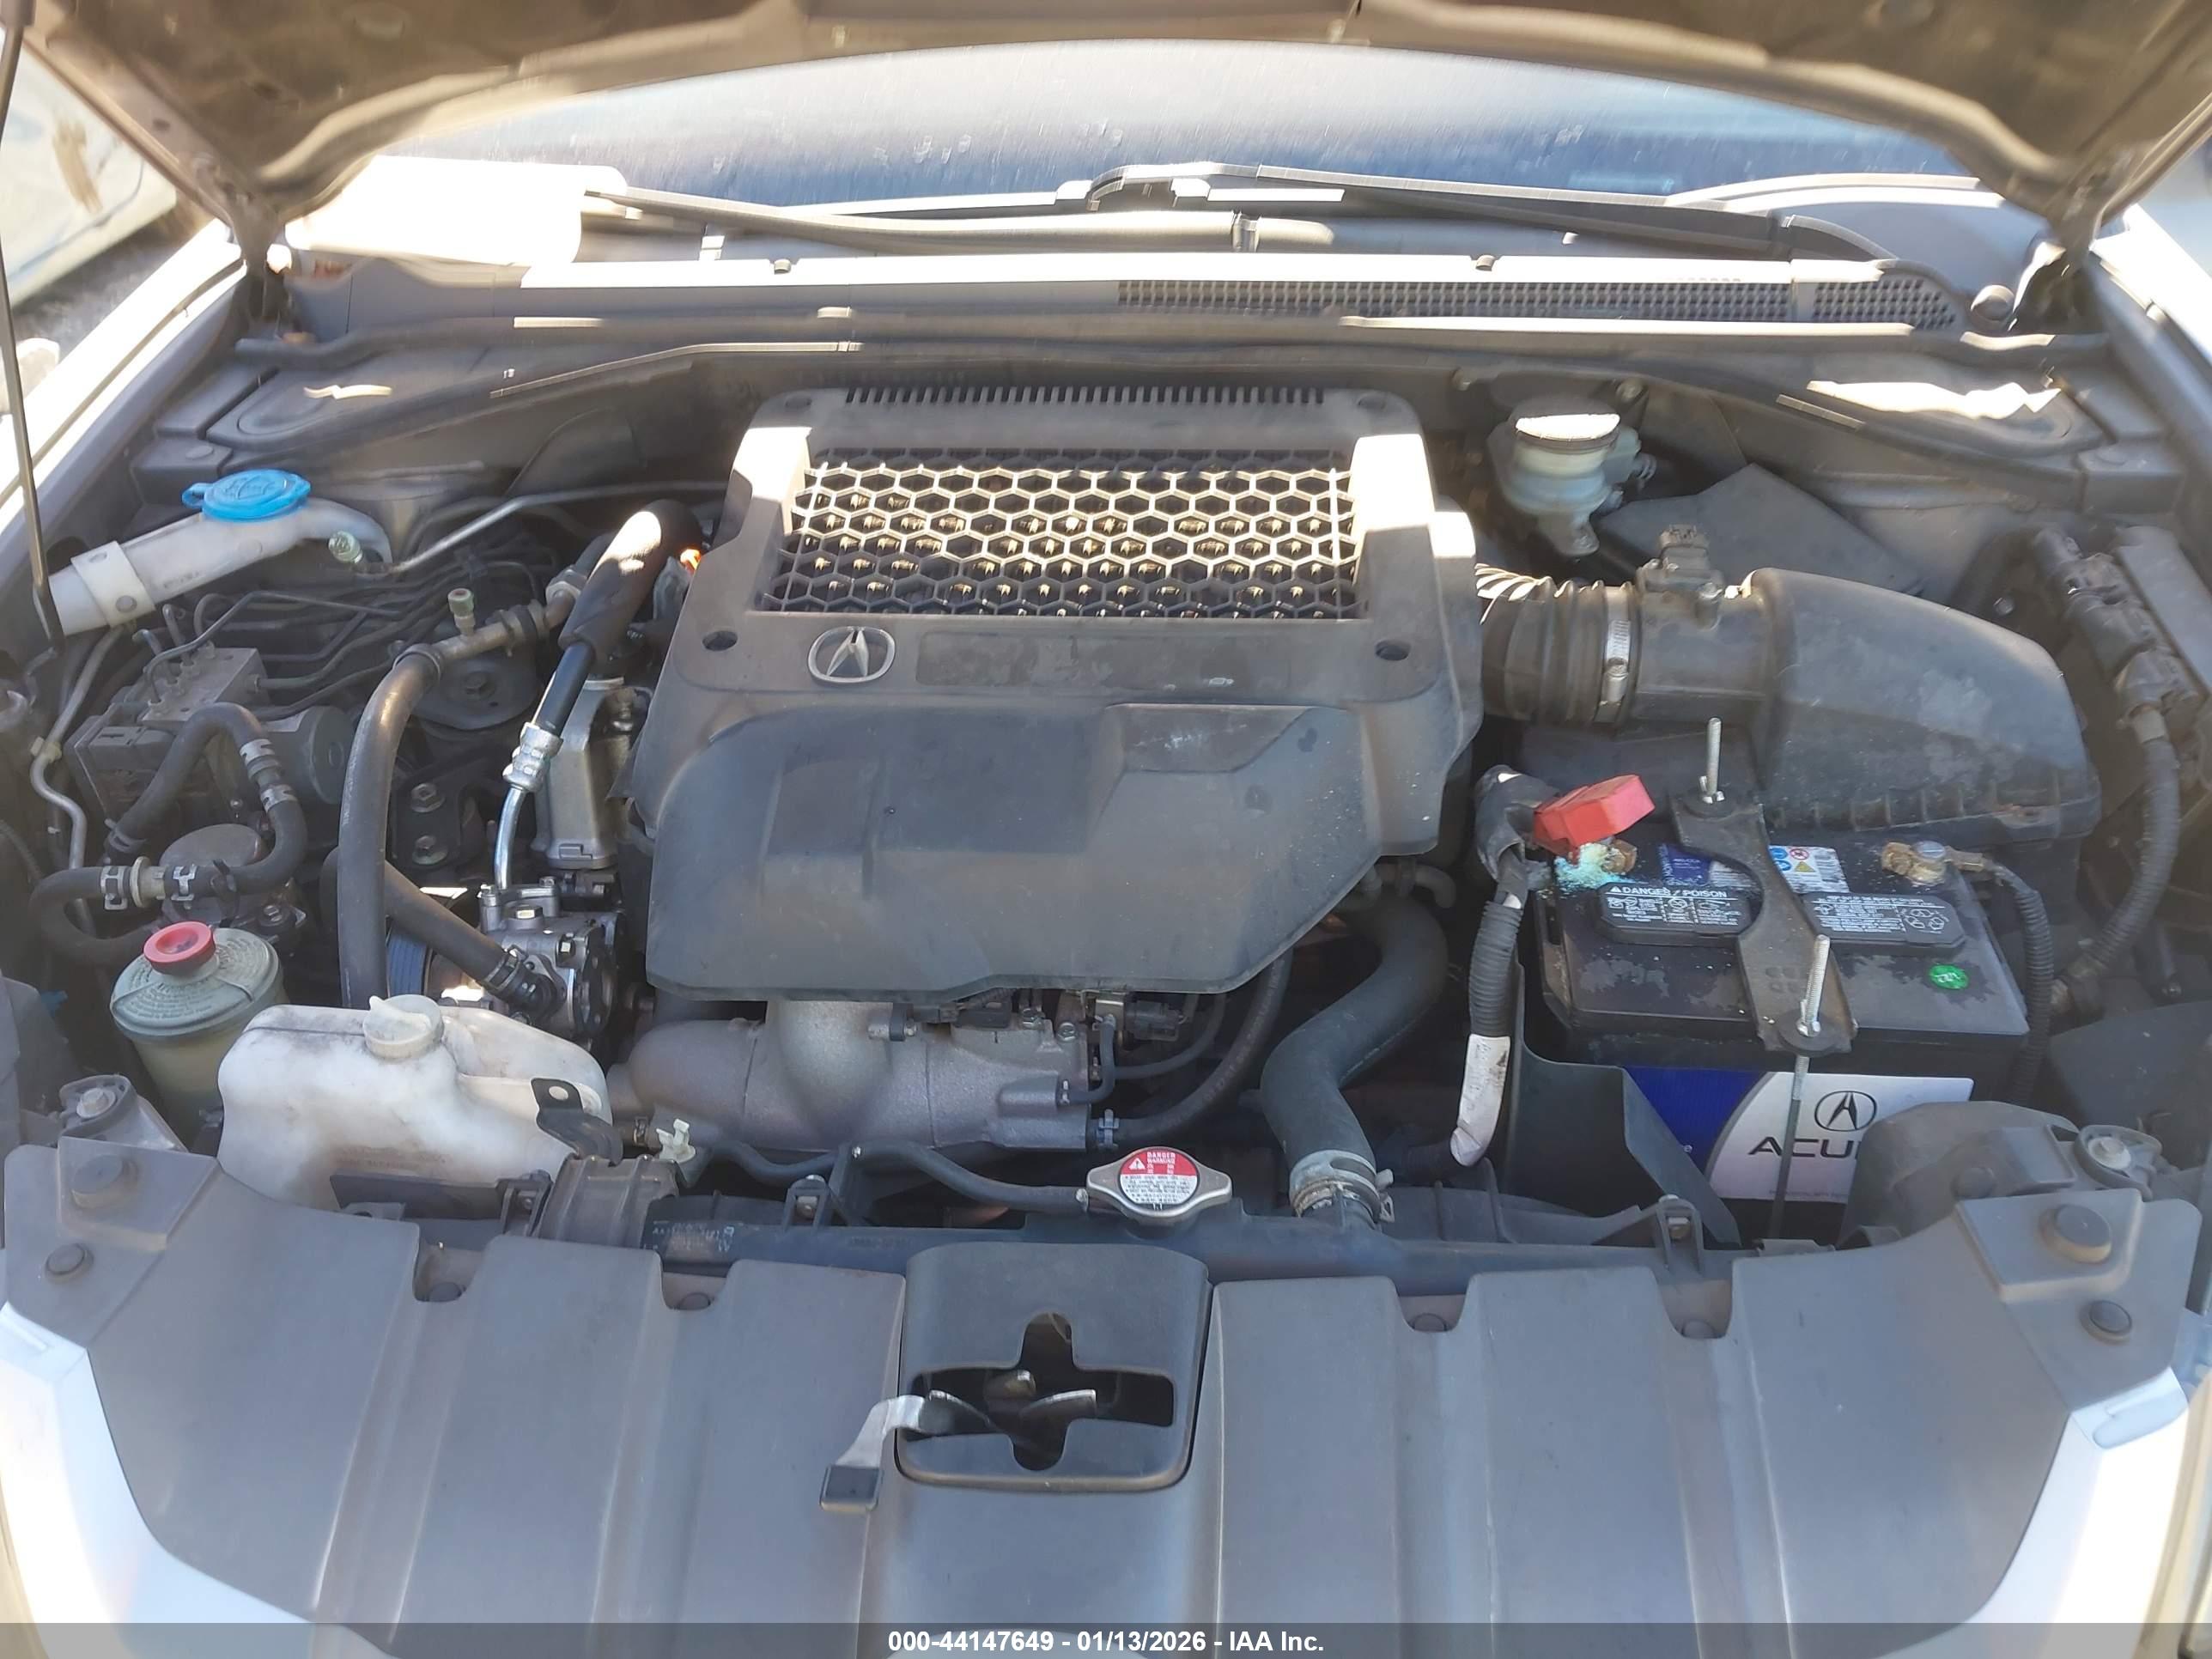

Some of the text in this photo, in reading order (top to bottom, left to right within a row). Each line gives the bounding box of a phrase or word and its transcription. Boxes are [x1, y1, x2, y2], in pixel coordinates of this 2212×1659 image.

[1622, 886, 1671, 896] DANGER
[1682, 890, 1728, 898] POISON
[1747, 1136, 1862, 1159] ACU
